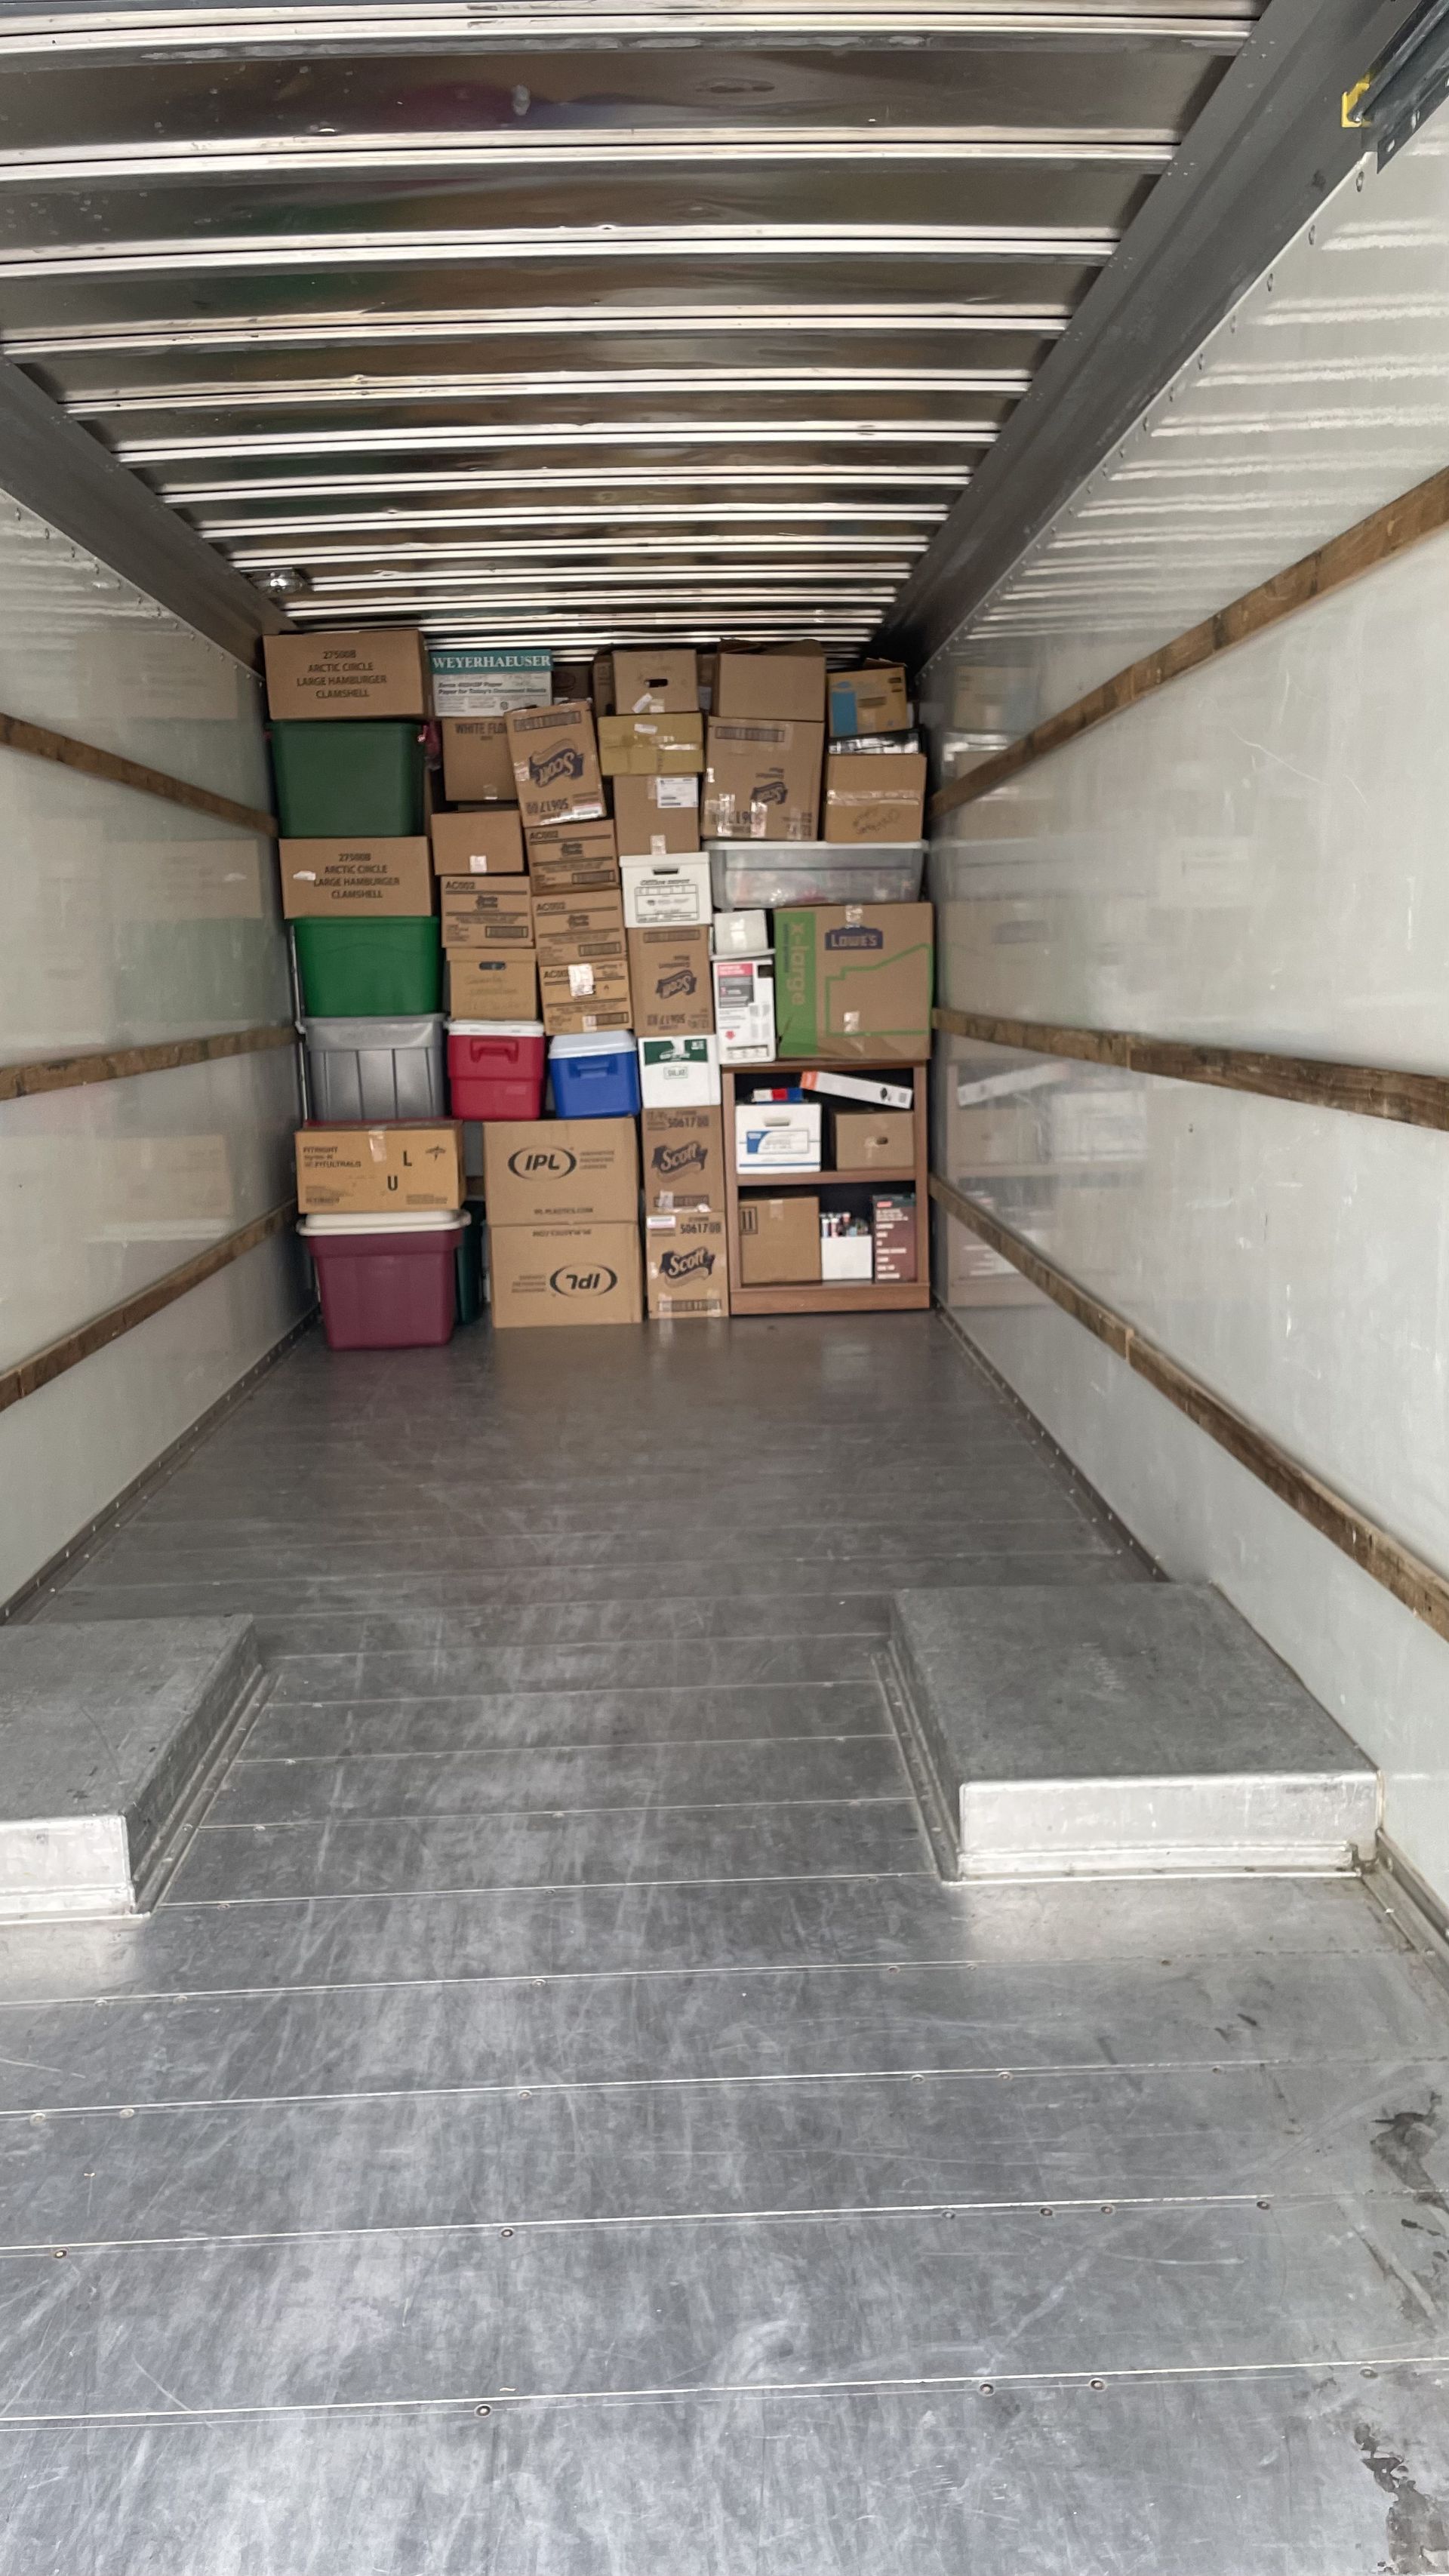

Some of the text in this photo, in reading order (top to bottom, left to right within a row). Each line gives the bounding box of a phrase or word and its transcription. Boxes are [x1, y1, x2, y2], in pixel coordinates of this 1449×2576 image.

[308, 662, 374, 672] ARCTIC CIRCLE
[433, 655, 551, 669] WEYERHAEUSER
[297, 675, 386, 687] LARGE HAMBURGER
[315, 689, 370, 698] CLAMSHELL
[539, 752, 574, 786] Scott
[325, 865, 387, 874] ARCTIC CIRCLE
[314, 877, 400, 887] LARGE HAMBURGER
[331, 890, 383, 899] CLAMSHELL
[831, 934, 878, 947] LOWE'S
[786, 924, 807, 1005] x-large
[403, 1150, 413, 1167] L
[525, 1154, 561, 1171] IPL
[661, 1143, 698, 1171] Scott
[387, 1175, 398, 1192] U
[668, 1248, 706, 1276] Scott
[566, 1273, 601, 1291] IPL
